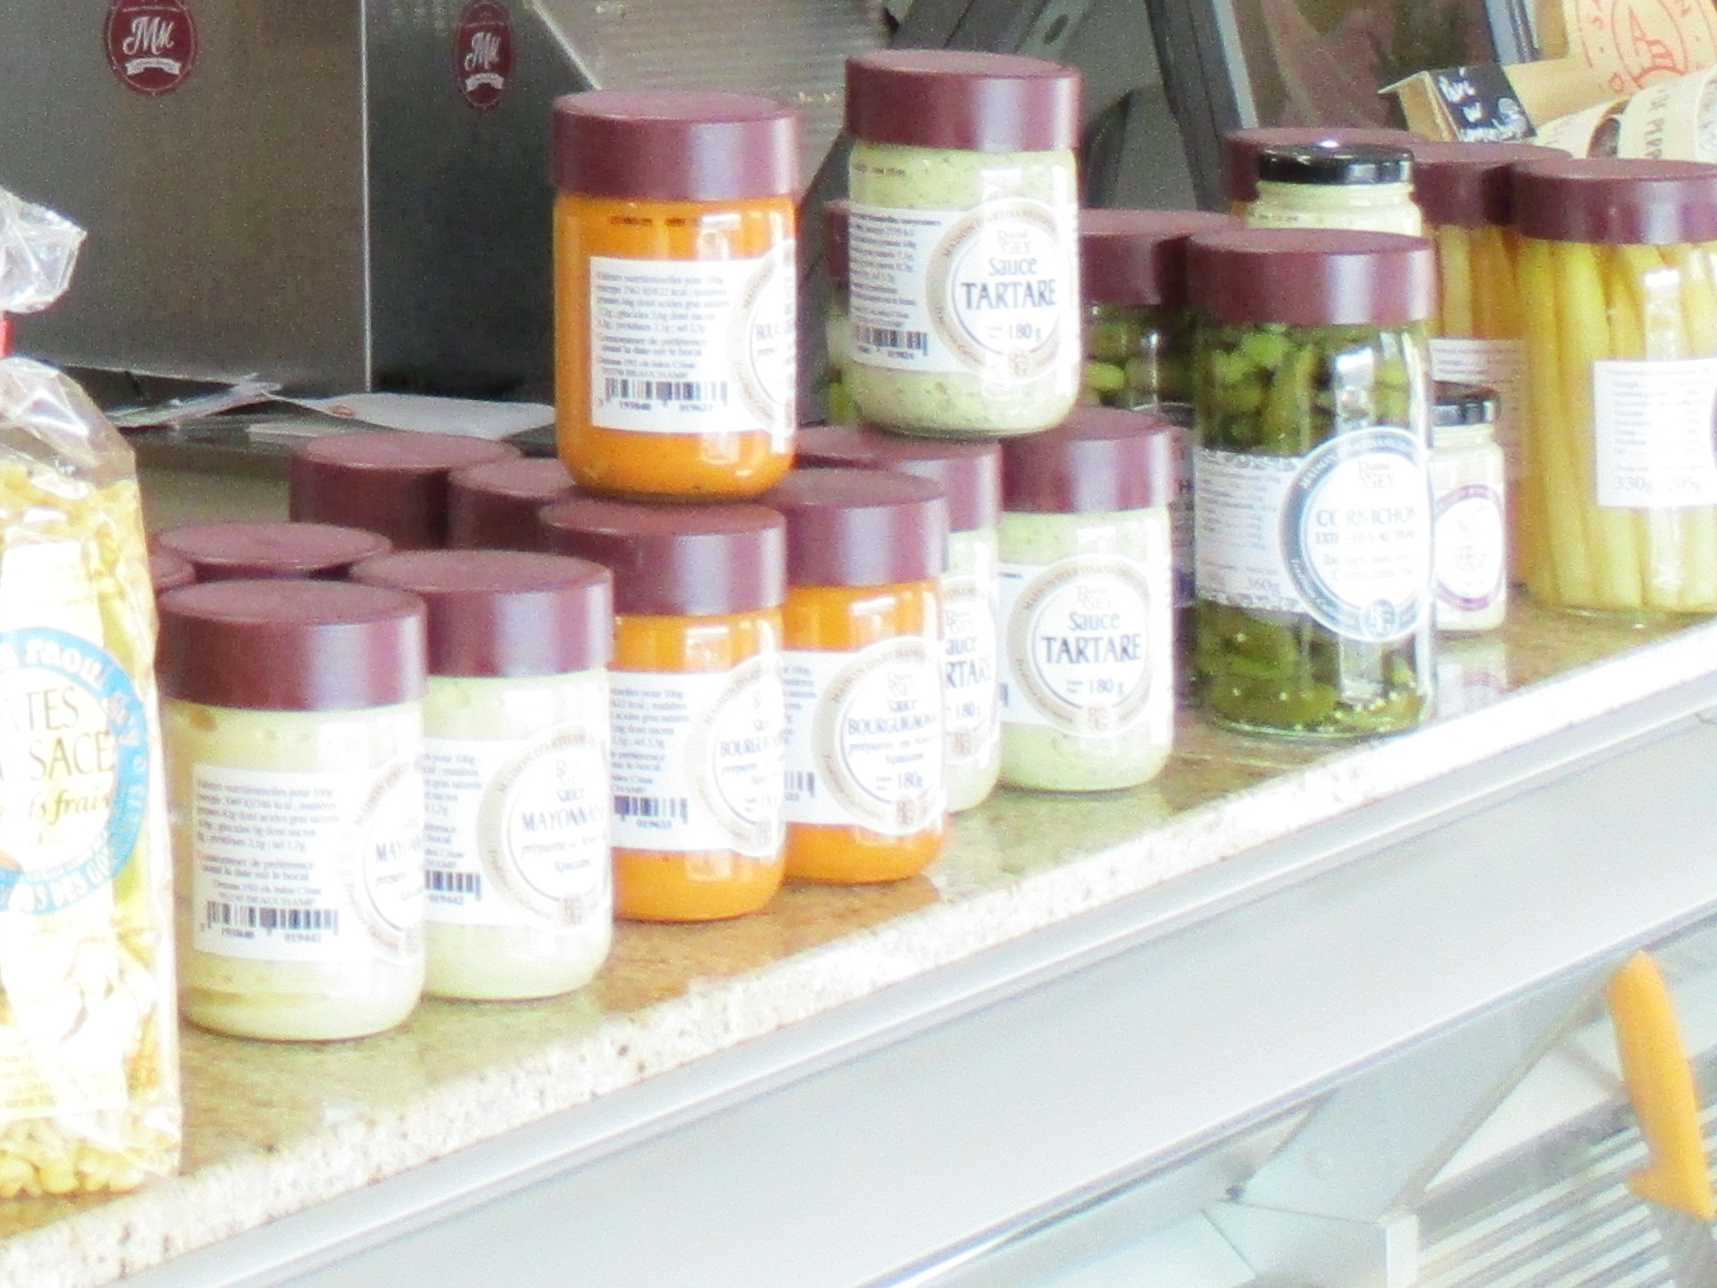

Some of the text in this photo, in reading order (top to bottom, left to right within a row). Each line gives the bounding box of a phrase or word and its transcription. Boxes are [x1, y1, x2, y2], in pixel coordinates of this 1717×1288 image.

[989, 257, 1038, 276] Sauce
[961, 279, 1057, 309] TARTARE
[1299, 447, 1338, 490] MAISON
[1069, 611, 1120, 631] Sauce
[945, 636, 977, 656] auce
[1041, 634, 1141, 664] TARTARE
[945, 657, 991, 690] RTARE
